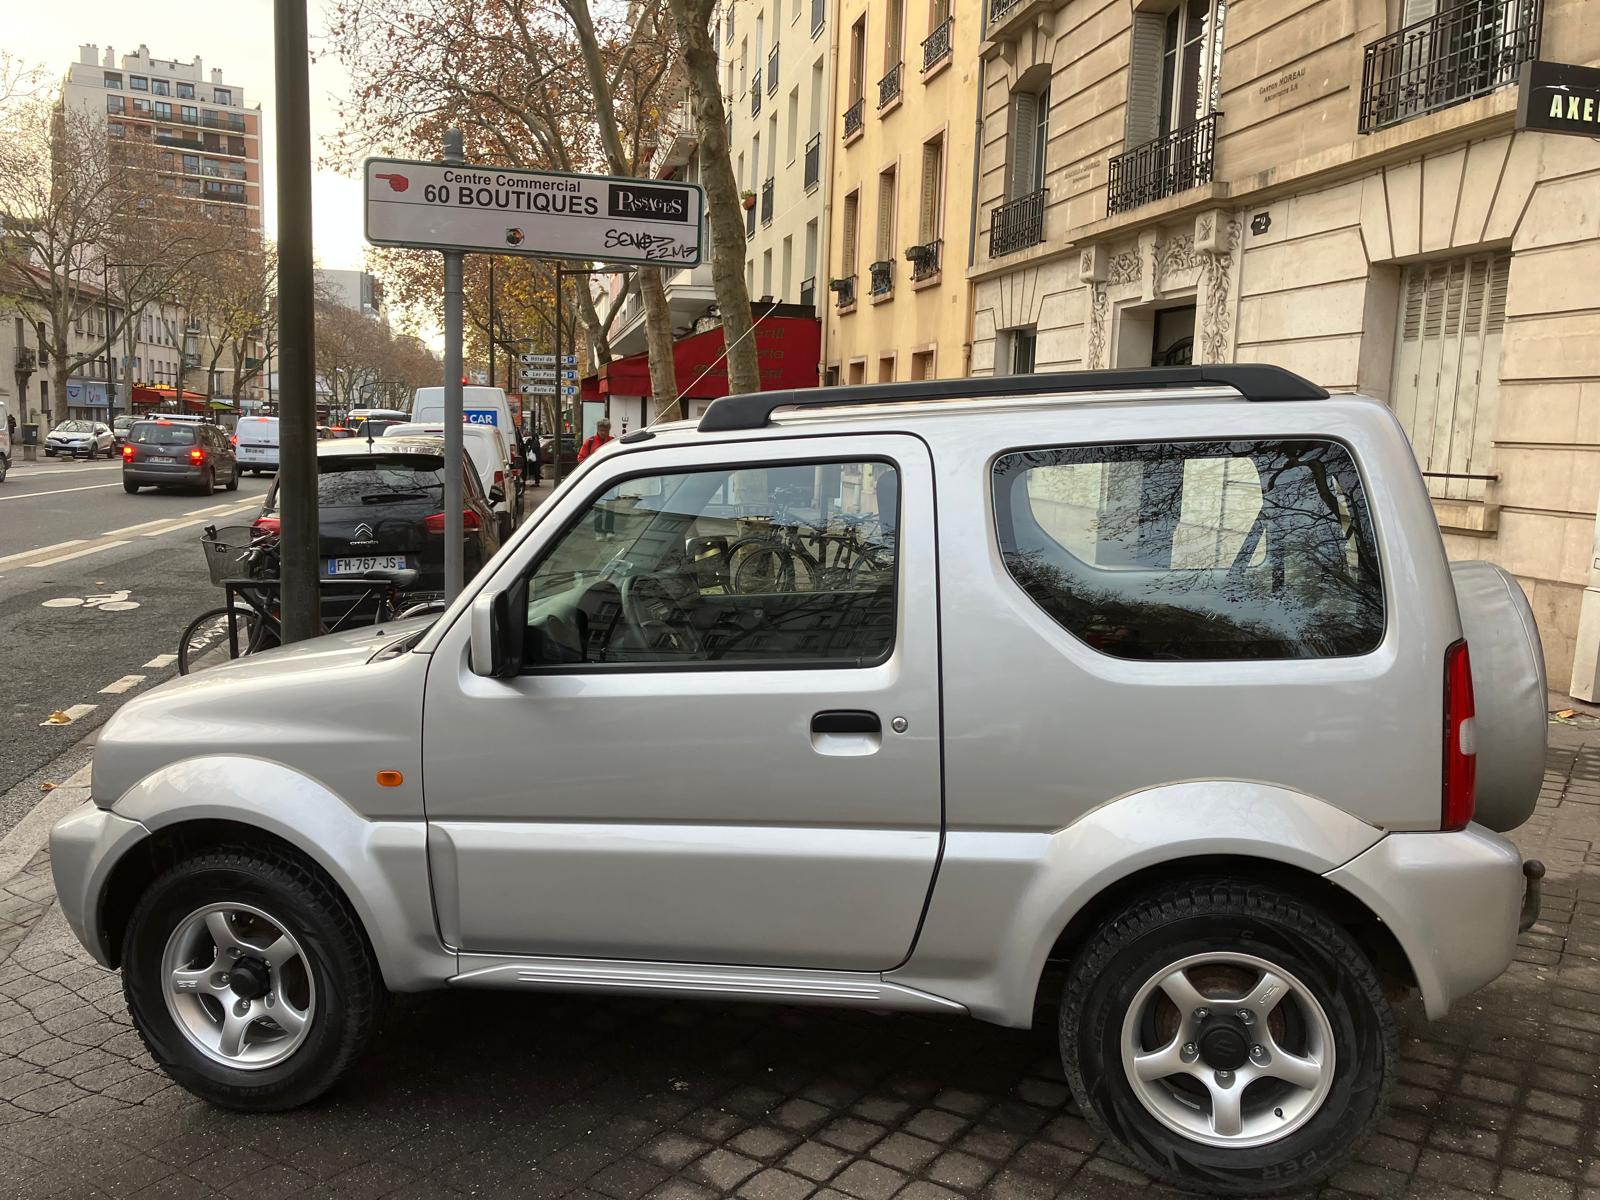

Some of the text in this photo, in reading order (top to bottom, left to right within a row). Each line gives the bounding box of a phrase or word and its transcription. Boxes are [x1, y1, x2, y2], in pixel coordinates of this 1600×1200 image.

[1279, 67, 1306, 86] MOREAU
[1549, 94, 1600, 123] AXE
[444, 171, 581, 193] Centre Commercial
[424, 185, 599, 215] 60 BOUTIQUES
[469, 414, 493, 424] CAR
